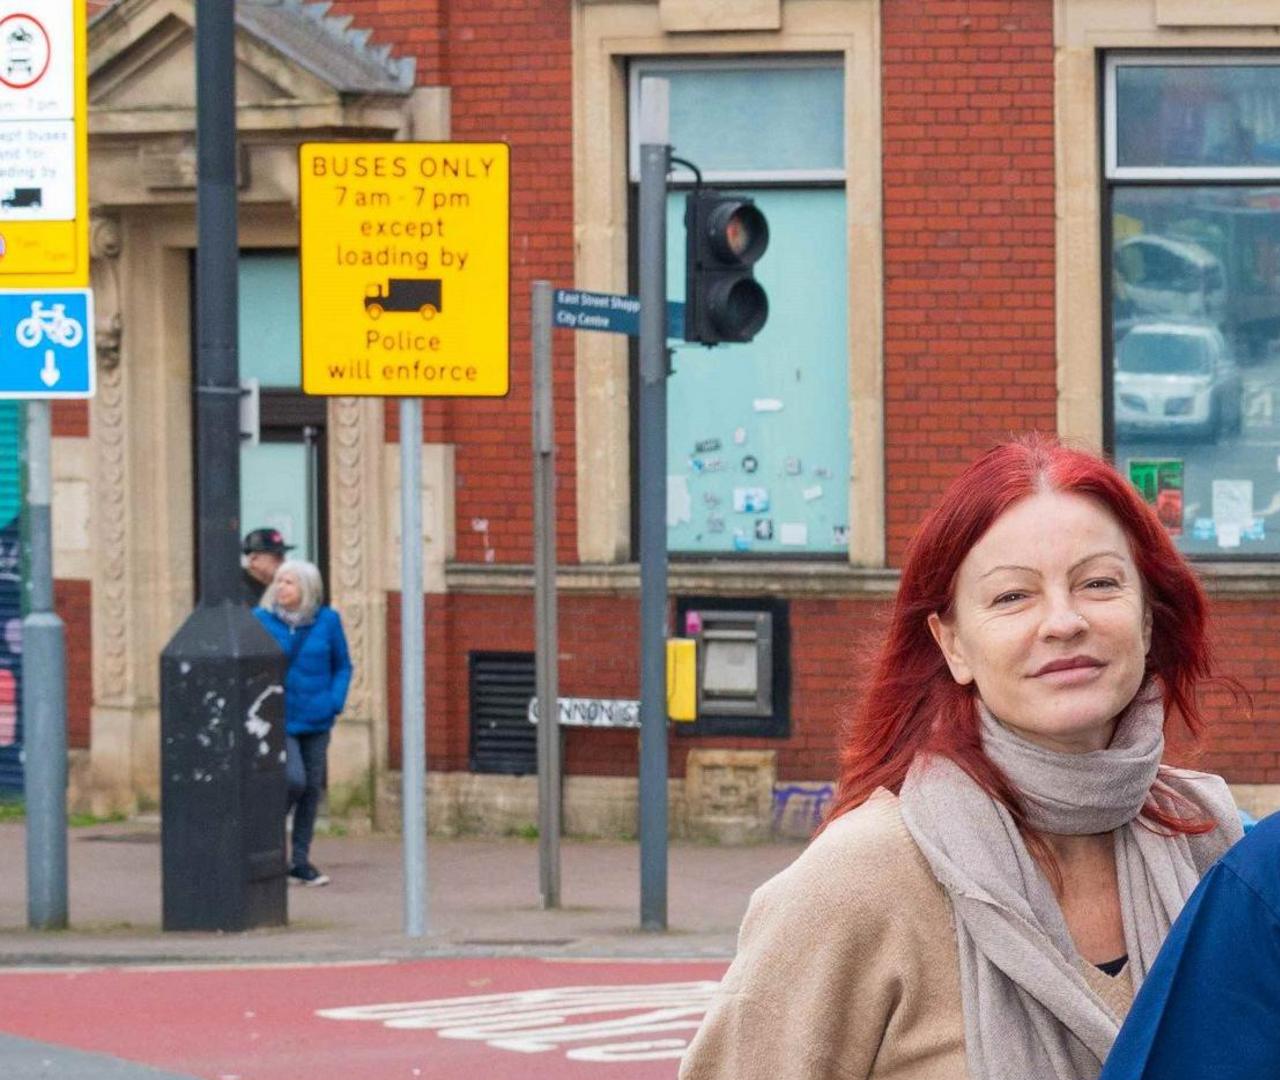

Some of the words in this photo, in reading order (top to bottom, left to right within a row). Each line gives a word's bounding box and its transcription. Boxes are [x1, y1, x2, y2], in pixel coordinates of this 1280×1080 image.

[312, 157, 407, 178] BUSES
[420, 157, 494, 178] ONLY
[361, 217, 444, 239] except
[337, 246, 429, 270] loading
[441, 246, 469, 270] by
[557, 289, 580, 306] East
[581, 292, 610, 310] Street
[556, 310, 577, 327] City
[577, 313, 610, 329] Centre
[366, 330, 441, 351] Police
[329, 360, 371, 380] will
[382, 360, 478, 381] enforce
